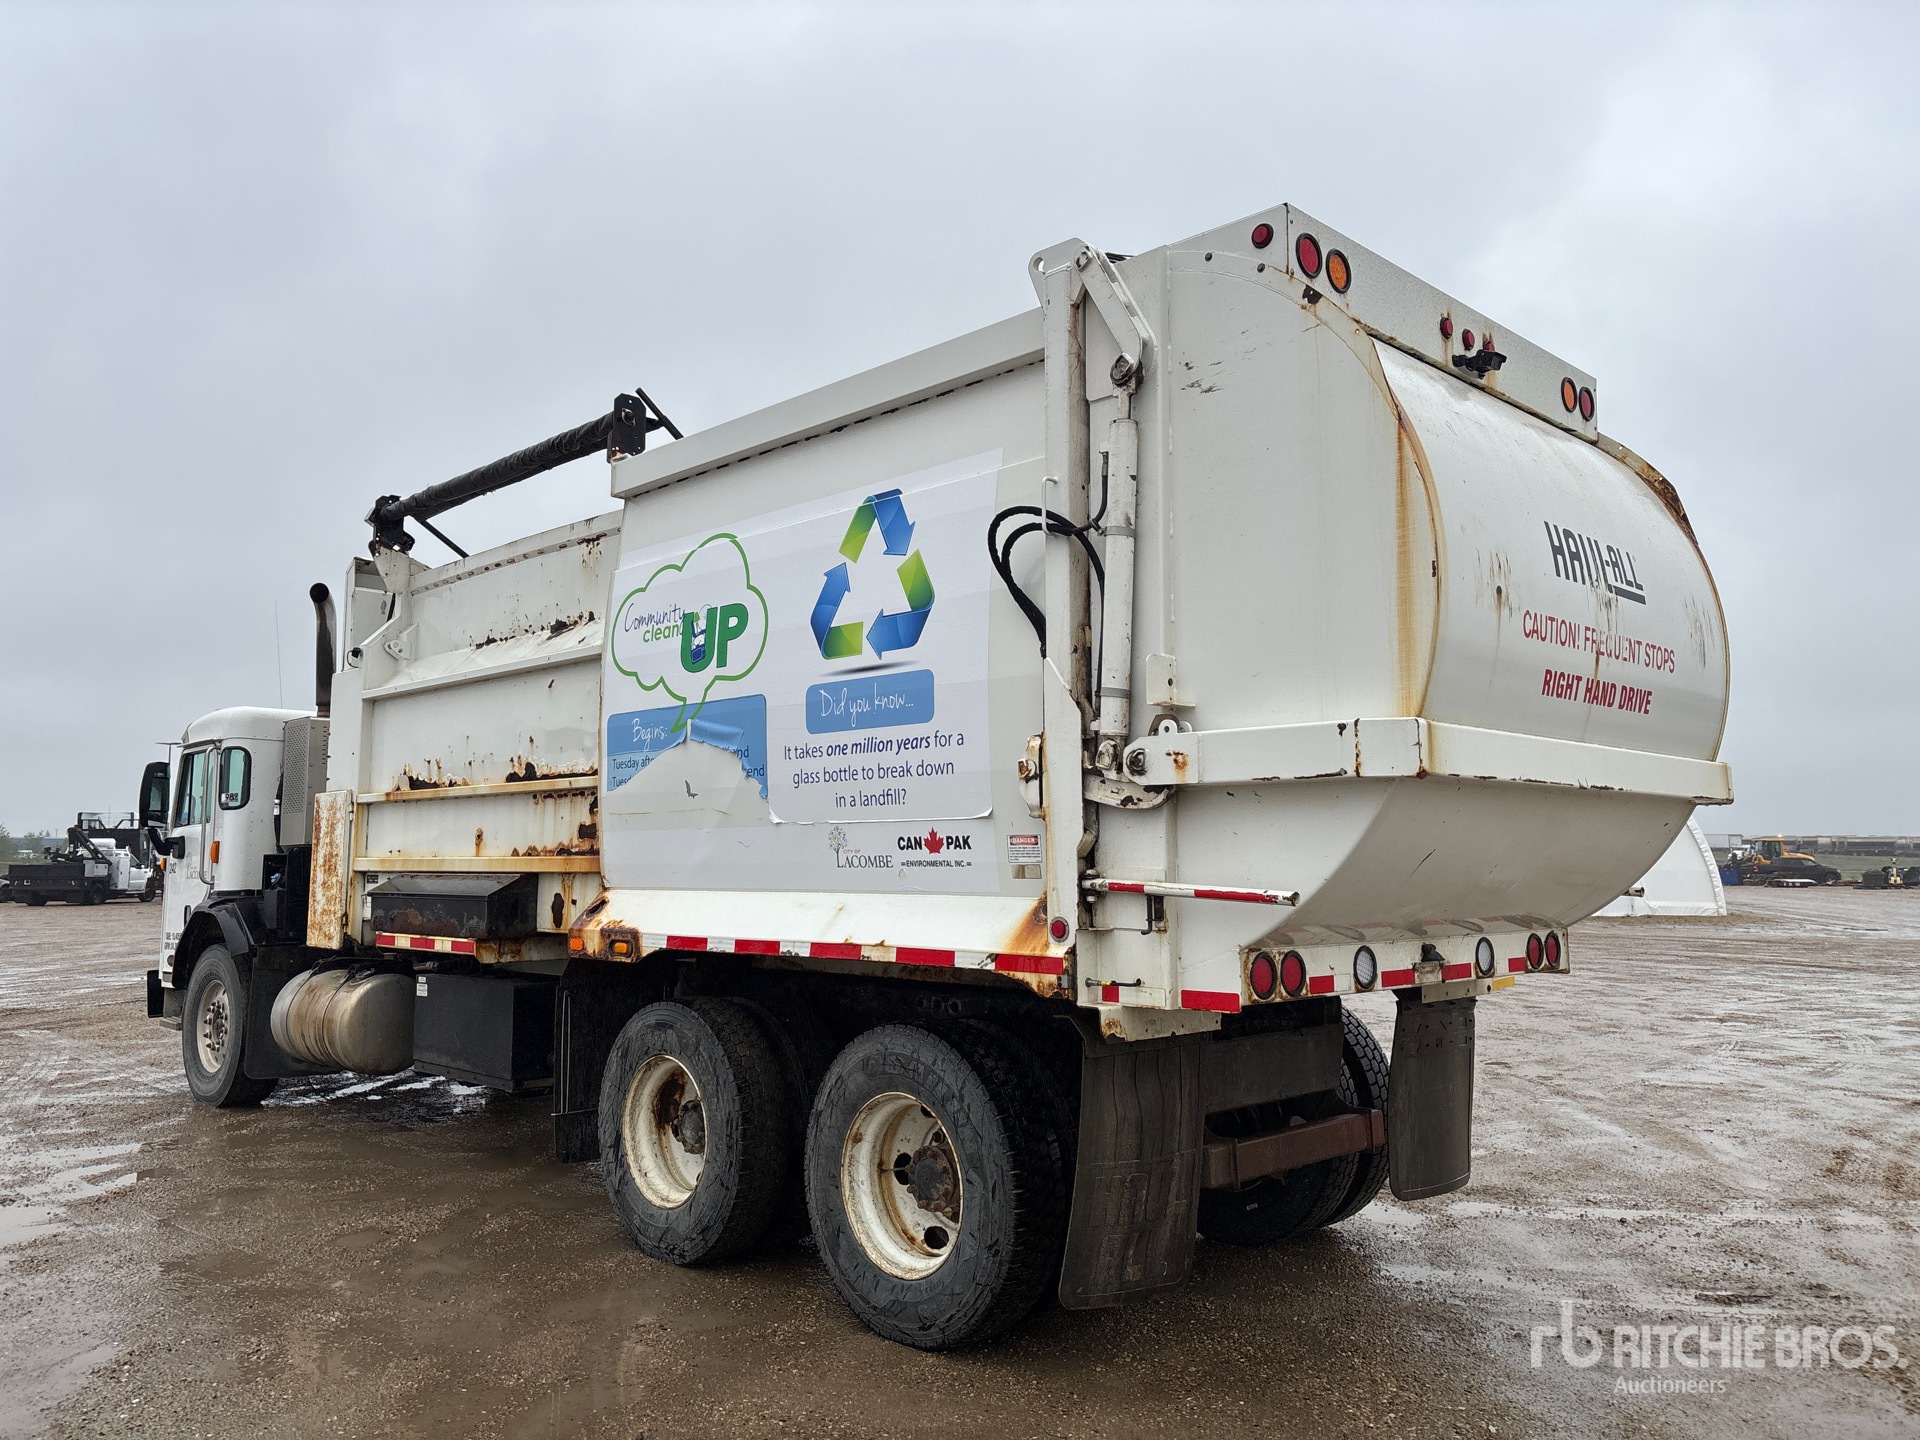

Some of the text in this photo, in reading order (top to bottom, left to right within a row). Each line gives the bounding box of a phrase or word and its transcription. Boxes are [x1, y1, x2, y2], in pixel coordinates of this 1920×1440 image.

[1544, 520, 1644, 593] HAUL-ALL
[624, 602, 686, 636] Community
[643, 602, 749, 673] clean UP
[1522, 610, 1676, 674] CAUTION! FREQUENT STOPS
[819, 682, 914, 728] Did you know...
[1541, 669, 1653, 715] RIGHT HAND DRIVE
[632, 718, 668, 752] Begins:
[784, 730, 964, 760] It takes one million years for a
[612, 756, 639, 771] Tuesday
[792, 759, 954, 788] glass bottle to break down
[835, 788, 907, 808] in a landfill?
[897, 835, 972, 851] CAN PAK
[837, 854, 894, 868] LACOMBE
[906, 860, 953, 868] ENVIRONMENTAL
